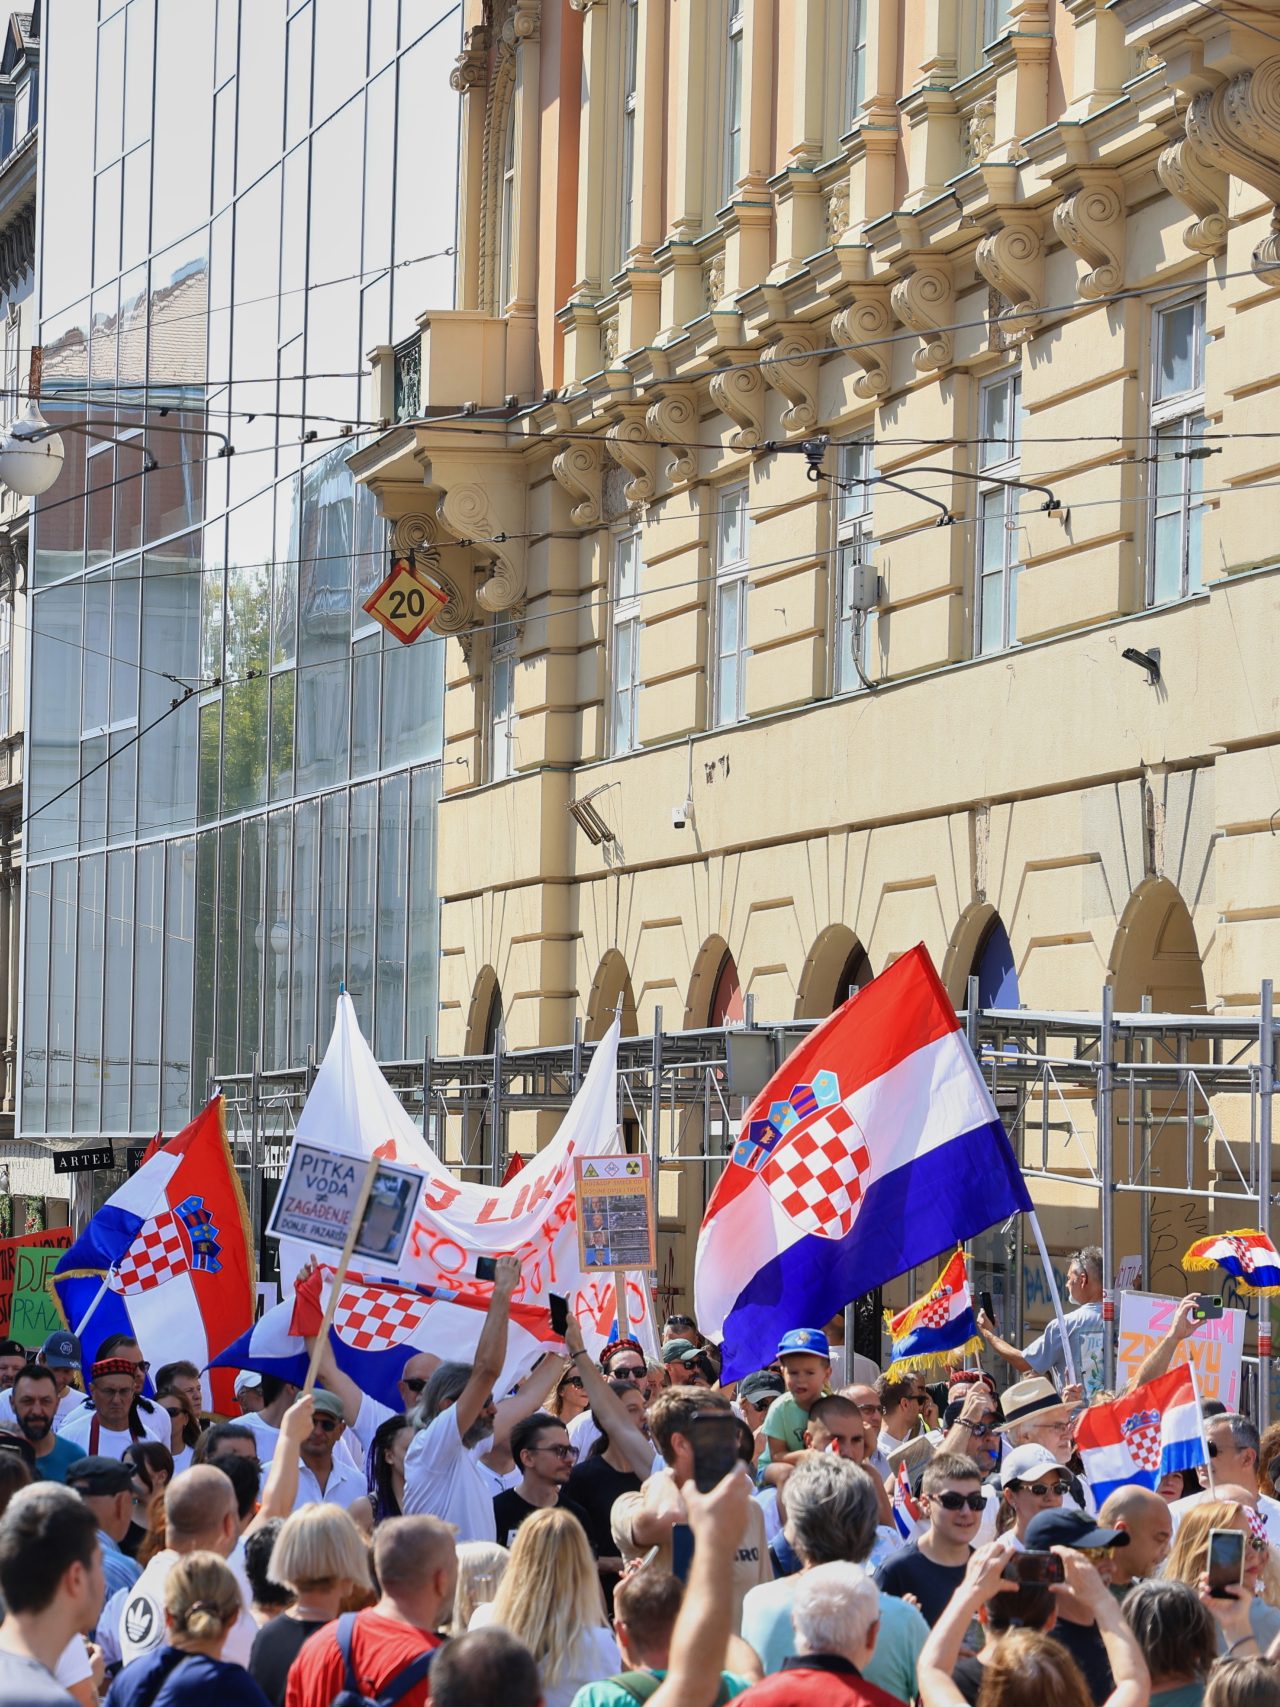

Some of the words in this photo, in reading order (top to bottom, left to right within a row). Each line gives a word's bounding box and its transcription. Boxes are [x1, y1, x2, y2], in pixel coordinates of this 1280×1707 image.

[59, 1153, 111, 1168] ARTEE
[299, 1154, 356, 1183] PITKA
[306, 1175, 349, 1198] VODA
[281, 1218, 308, 1235] DONJE
